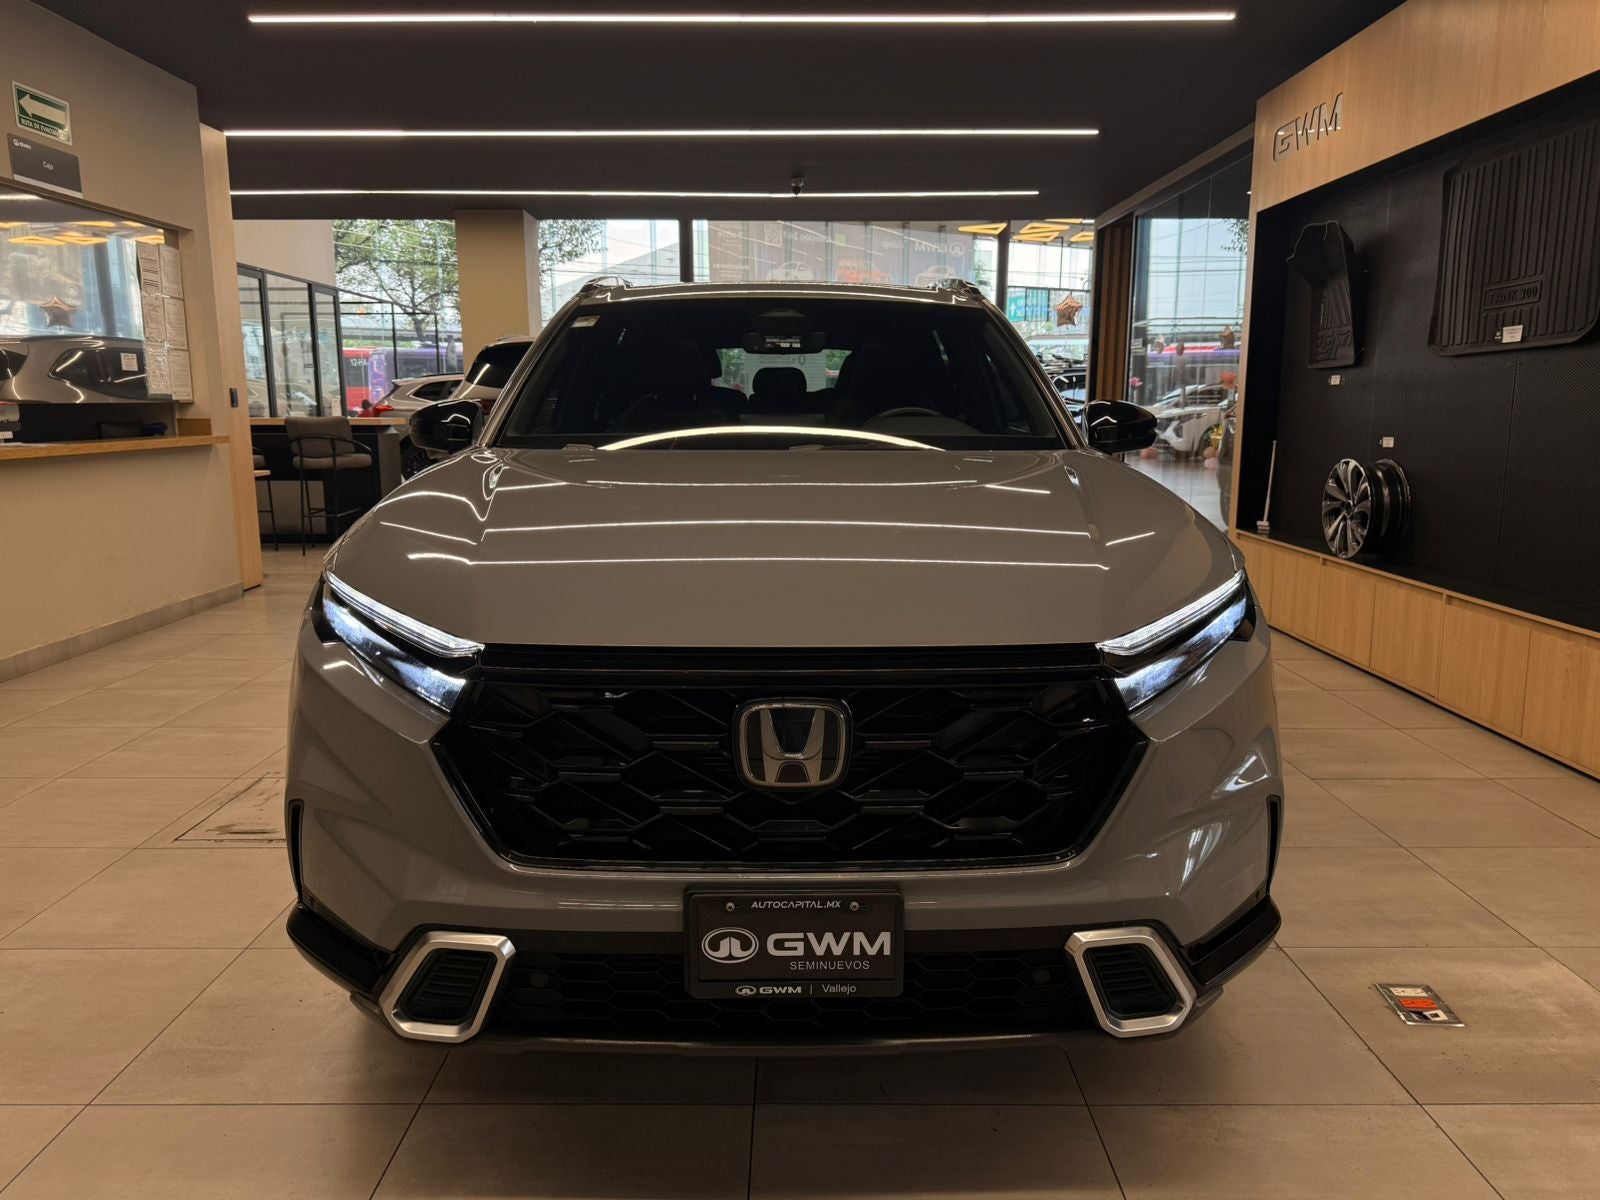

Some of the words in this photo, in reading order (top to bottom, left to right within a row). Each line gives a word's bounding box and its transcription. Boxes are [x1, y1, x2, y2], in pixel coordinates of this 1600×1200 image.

[1273, 92, 1343, 162] GWM
[1488, 288, 1519, 305] TANK
[1520, 285, 1538, 300] 300
[750, 900, 842, 909] AUTOCAPITAL.MX
[766, 931, 891, 957] GWM
[789, 960, 870, 970] SEMINUEVOS
[759, 986, 802, 994] GWM
[822, 984, 857, 994] Vallejo
